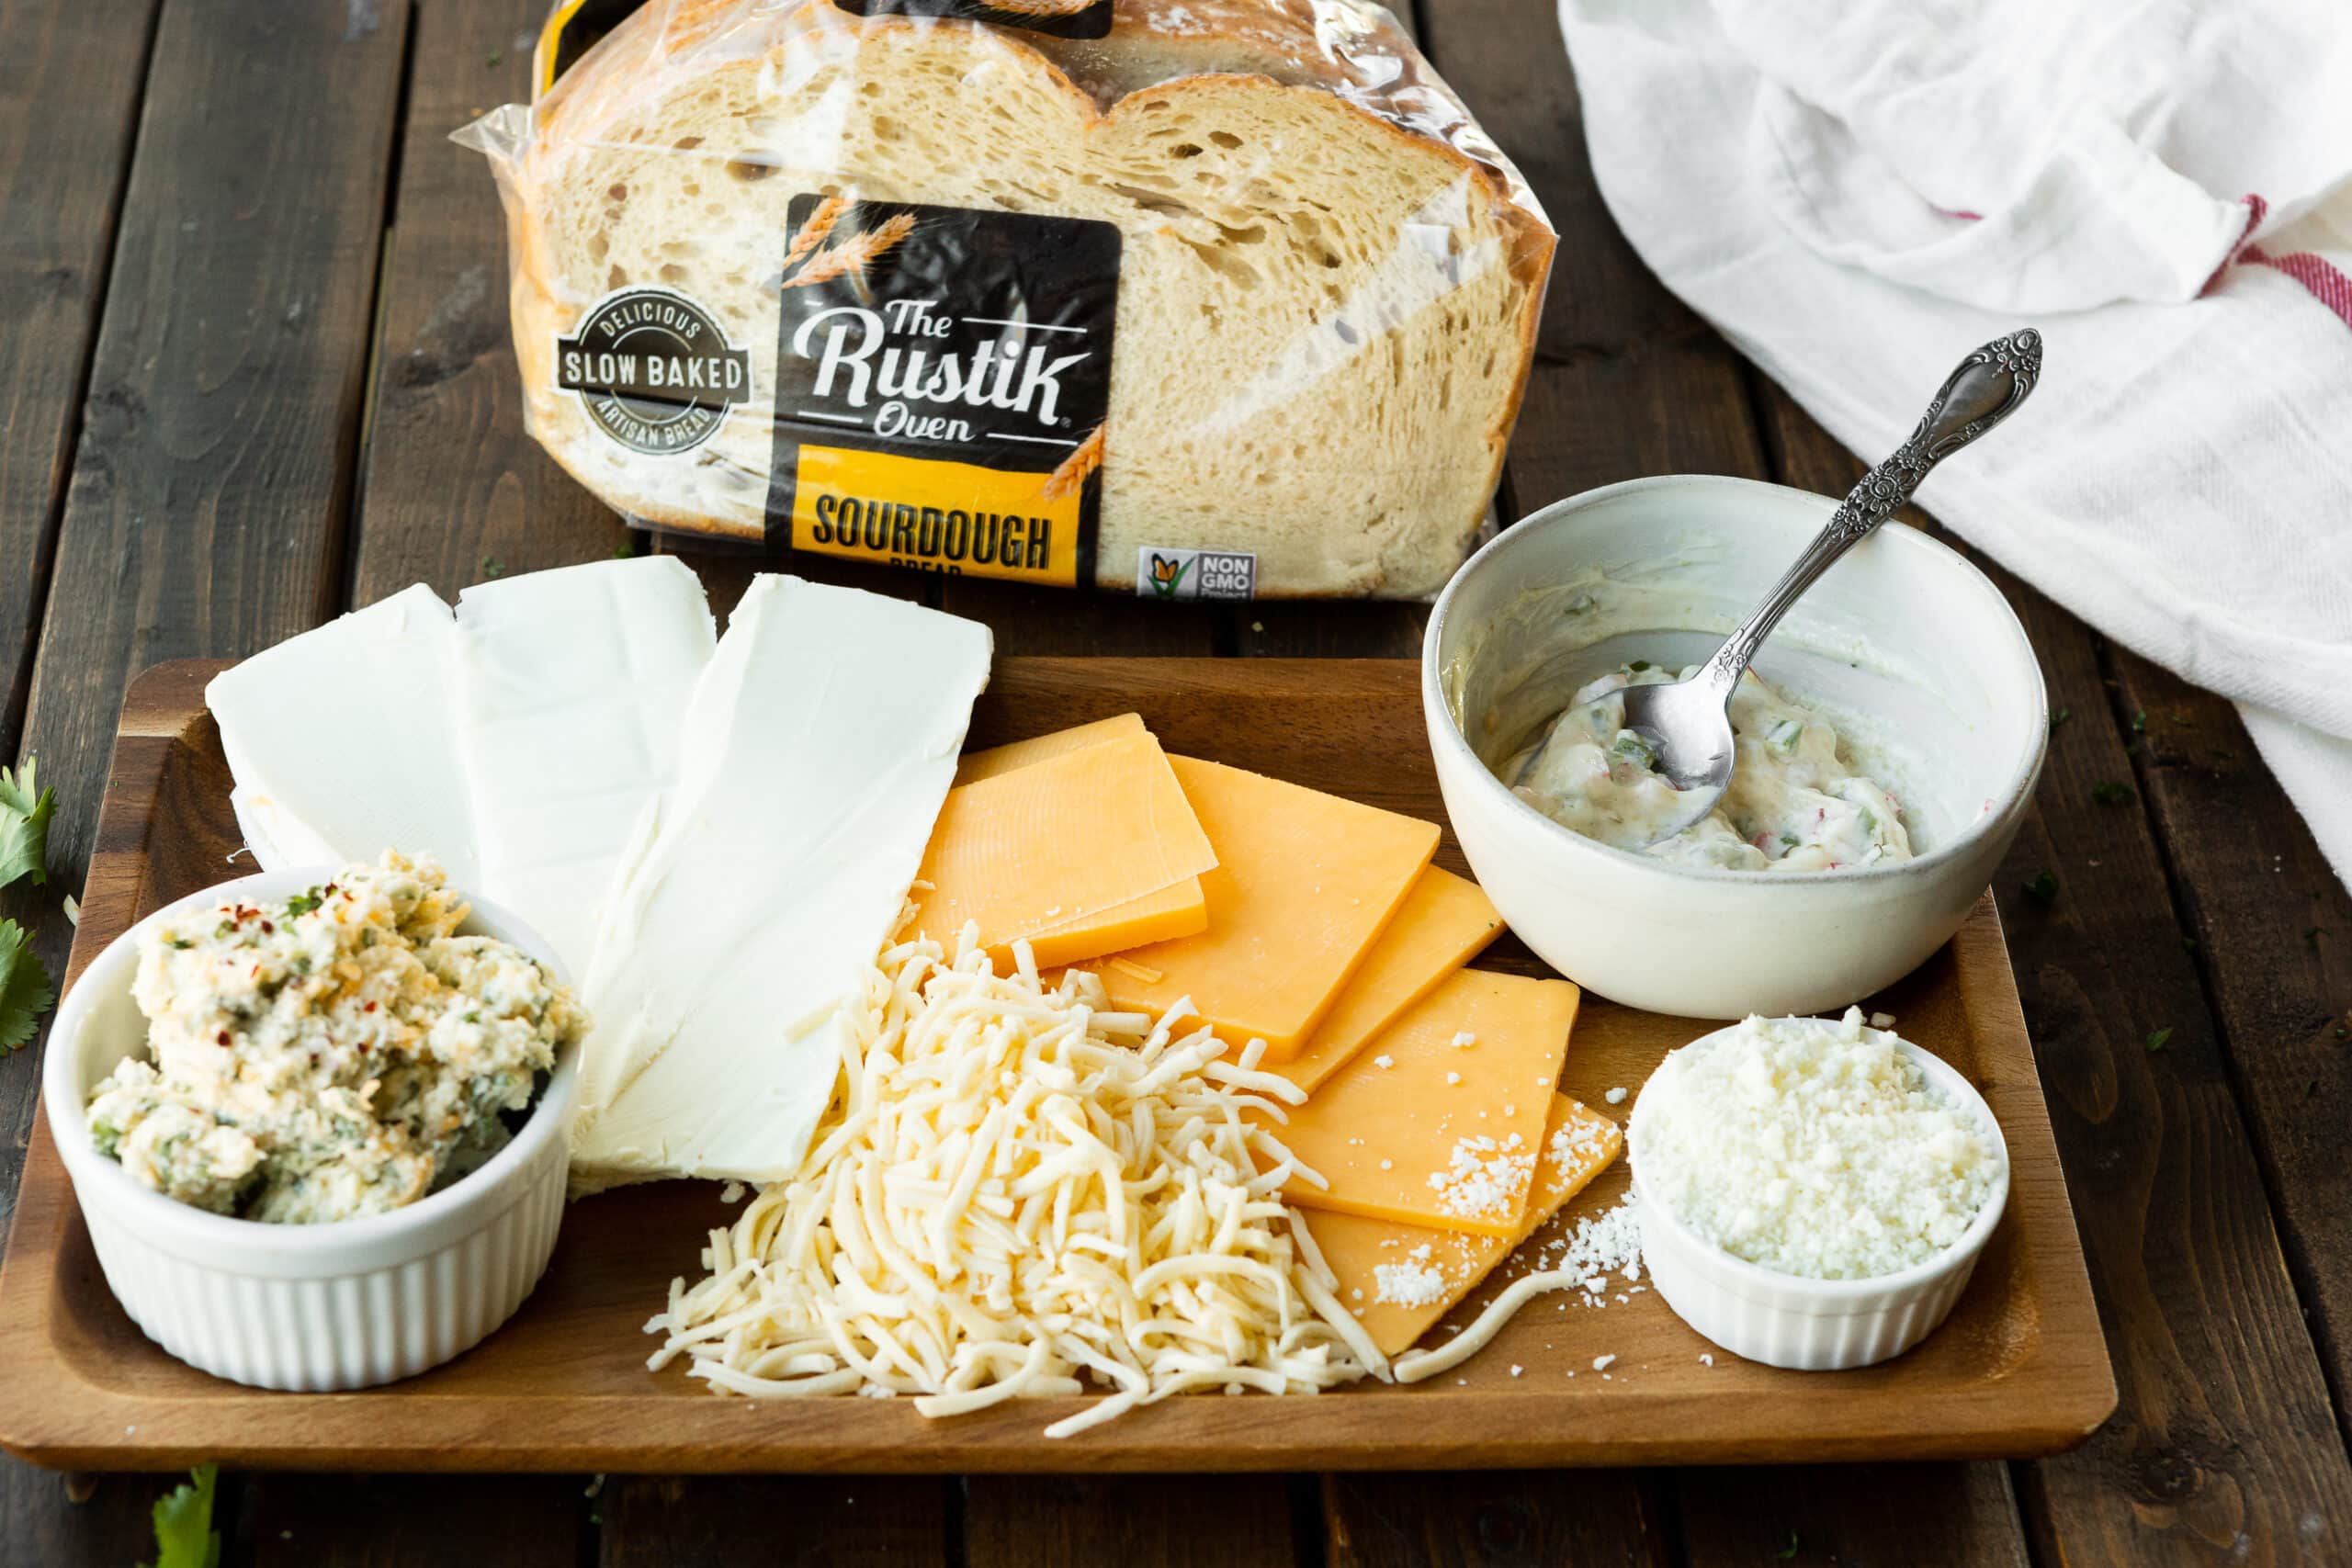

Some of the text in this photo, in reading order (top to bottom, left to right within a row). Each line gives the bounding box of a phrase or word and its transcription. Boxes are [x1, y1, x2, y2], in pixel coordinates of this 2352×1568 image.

[599, 302, 701, 338] DELICIOUS
[885, 299, 953, 338] The
[565, 352, 742, 389] SLOW BAKED
[793, 306, 1092, 427] Rustik
[596, 398, 711, 446] ARTISAN BREAD
[873, 400, 977, 442] Oven
[812, 493, 1054, 570] SOURDOUGH
[1201, 572, 1250, 591] GMO
[1203, 557, 1250, 574] NON
